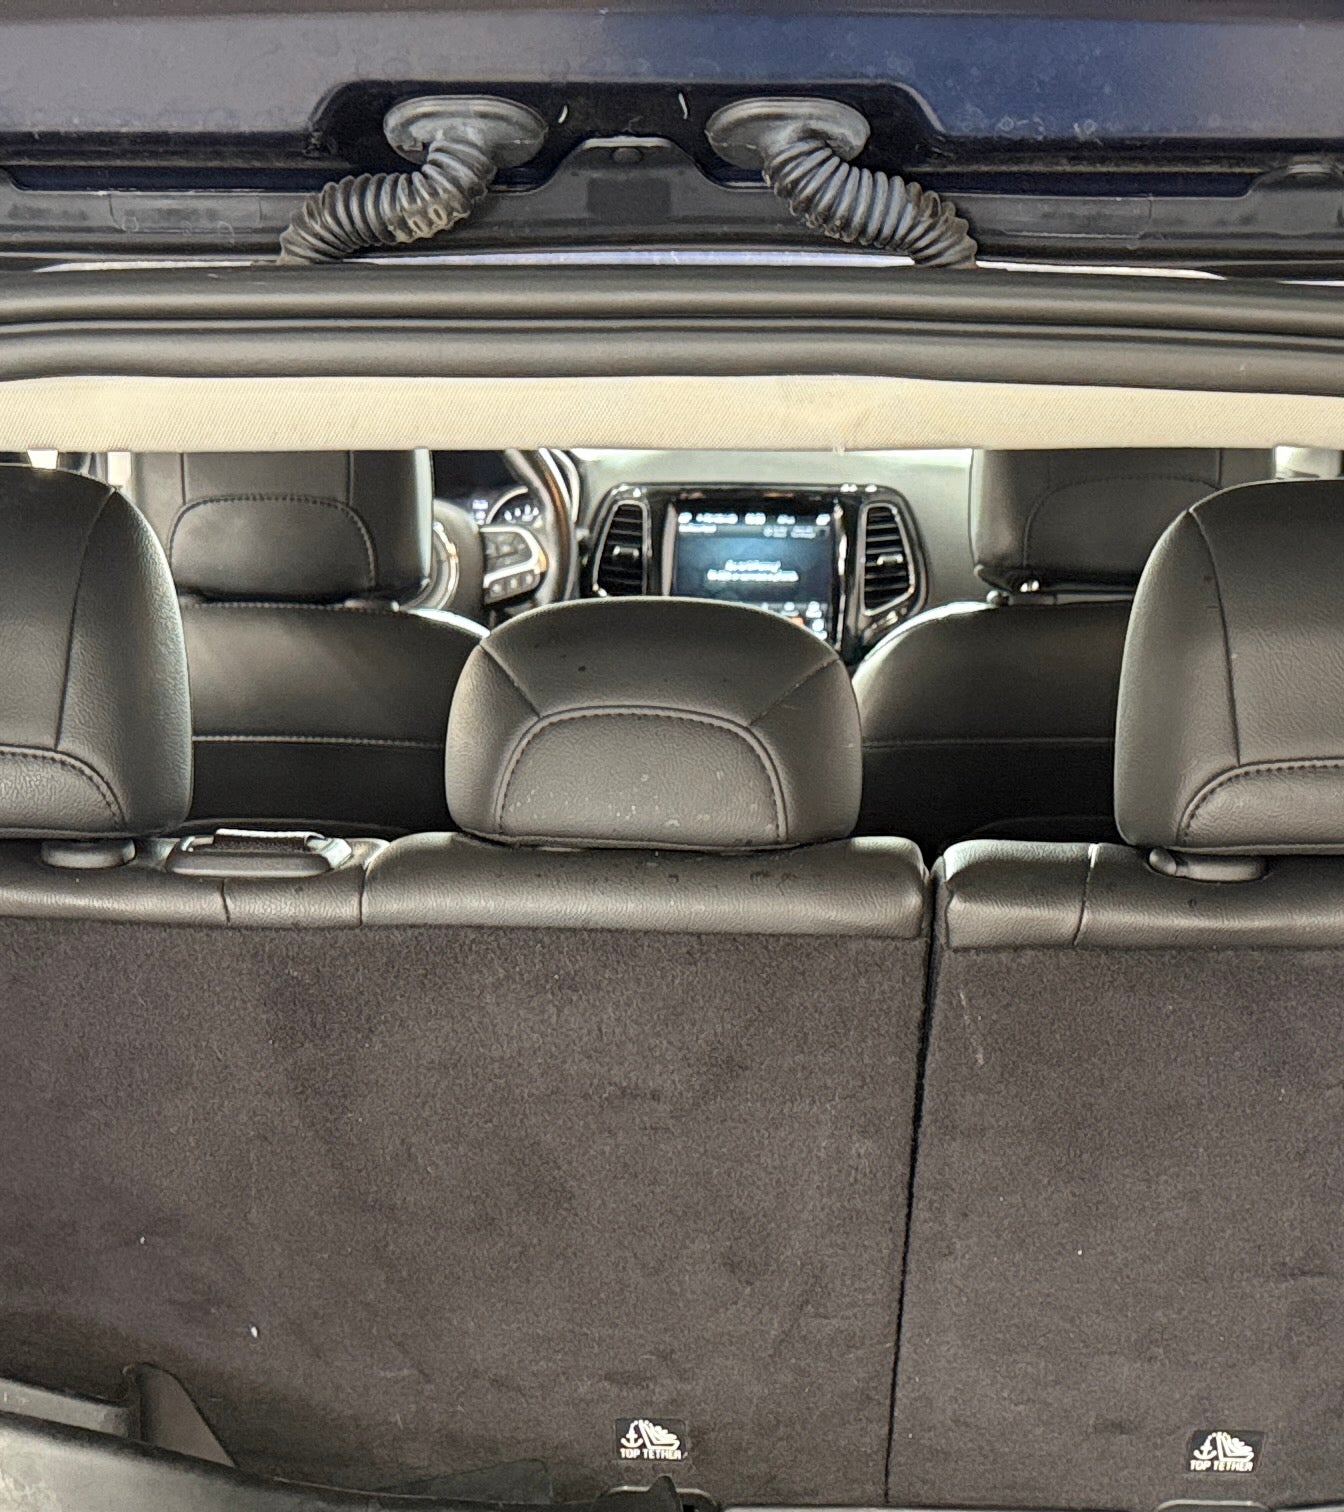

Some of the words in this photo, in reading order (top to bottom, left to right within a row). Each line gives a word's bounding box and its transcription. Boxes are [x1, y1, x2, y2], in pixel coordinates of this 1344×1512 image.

[620, 1448, 641, 1459] TOP
[642, 1448, 682, 1460] TETHER
[1190, 1459, 1211, 1471] TOP
[1213, 1460, 1254, 1472] TETHER
